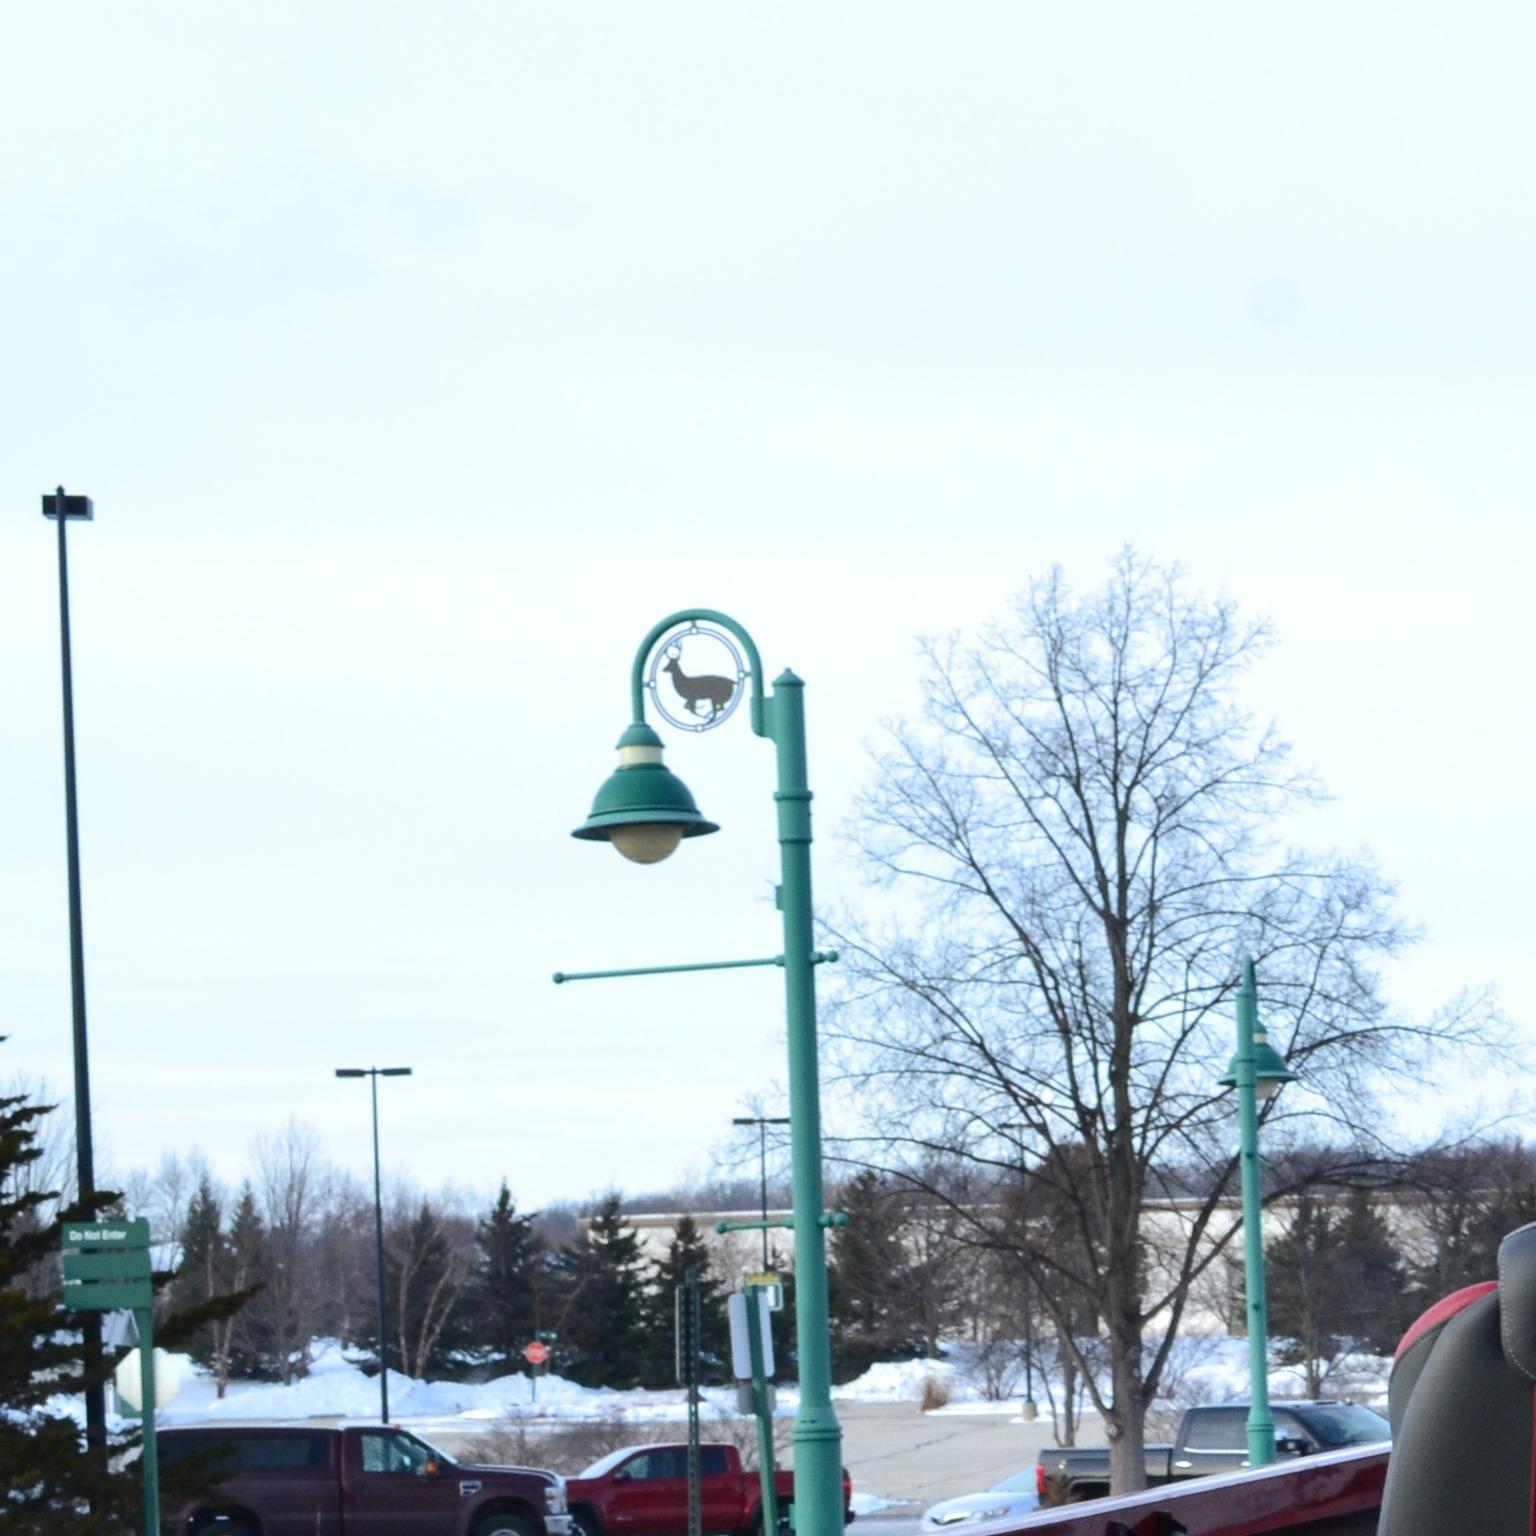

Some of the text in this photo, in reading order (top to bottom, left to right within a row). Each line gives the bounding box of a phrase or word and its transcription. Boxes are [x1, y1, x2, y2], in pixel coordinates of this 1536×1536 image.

[69, 1230, 127, 1241] Do Not Enter
